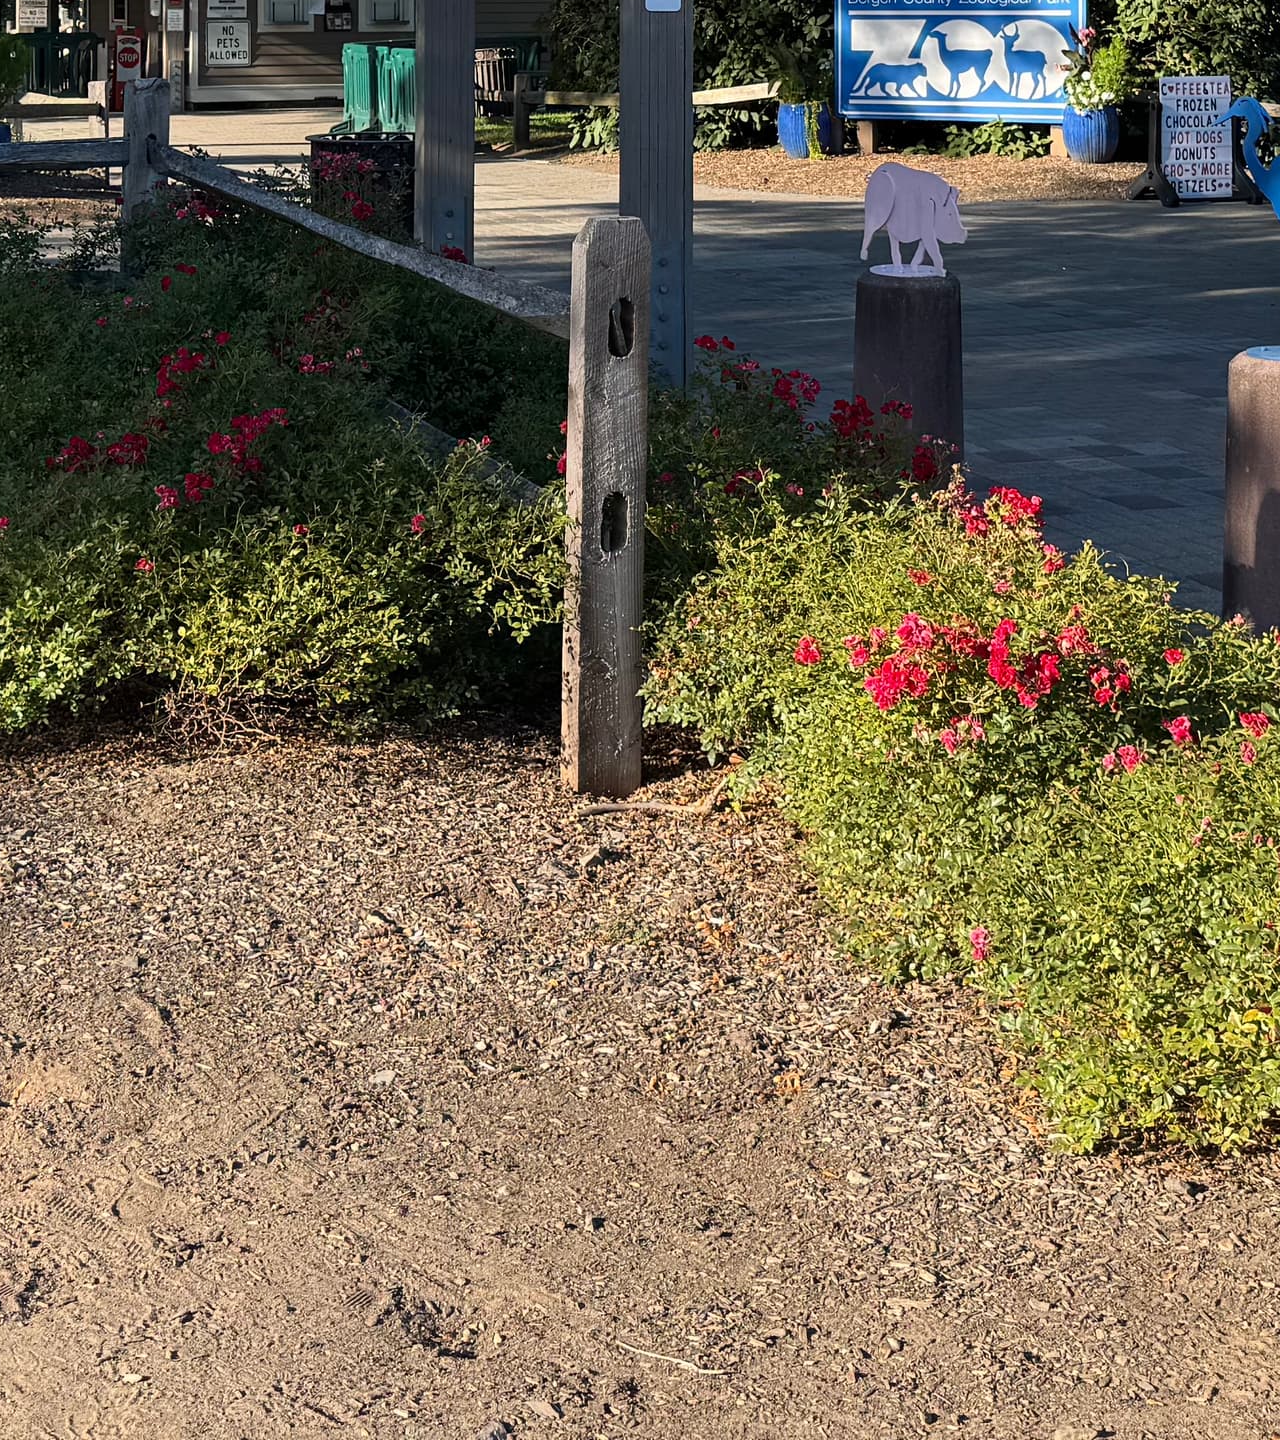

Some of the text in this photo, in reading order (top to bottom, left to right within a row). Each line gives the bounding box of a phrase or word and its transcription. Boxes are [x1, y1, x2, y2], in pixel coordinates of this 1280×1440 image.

[222, 26, 235, 36] NO
[217, 38, 240, 49] PETS
[119, 53, 138, 62] STOP
[209, 50, 248, 61] ALLOWED
[850, 18, 1071, 100] ZOO
[1176, 98, 1217, 113] FROZEN
[1170, 131, 1223, 145] HOT DOGS
[1175, 146, 1216, 161] DONUTS
[1163, 163, 1230, 178] CRO-S'MORE
